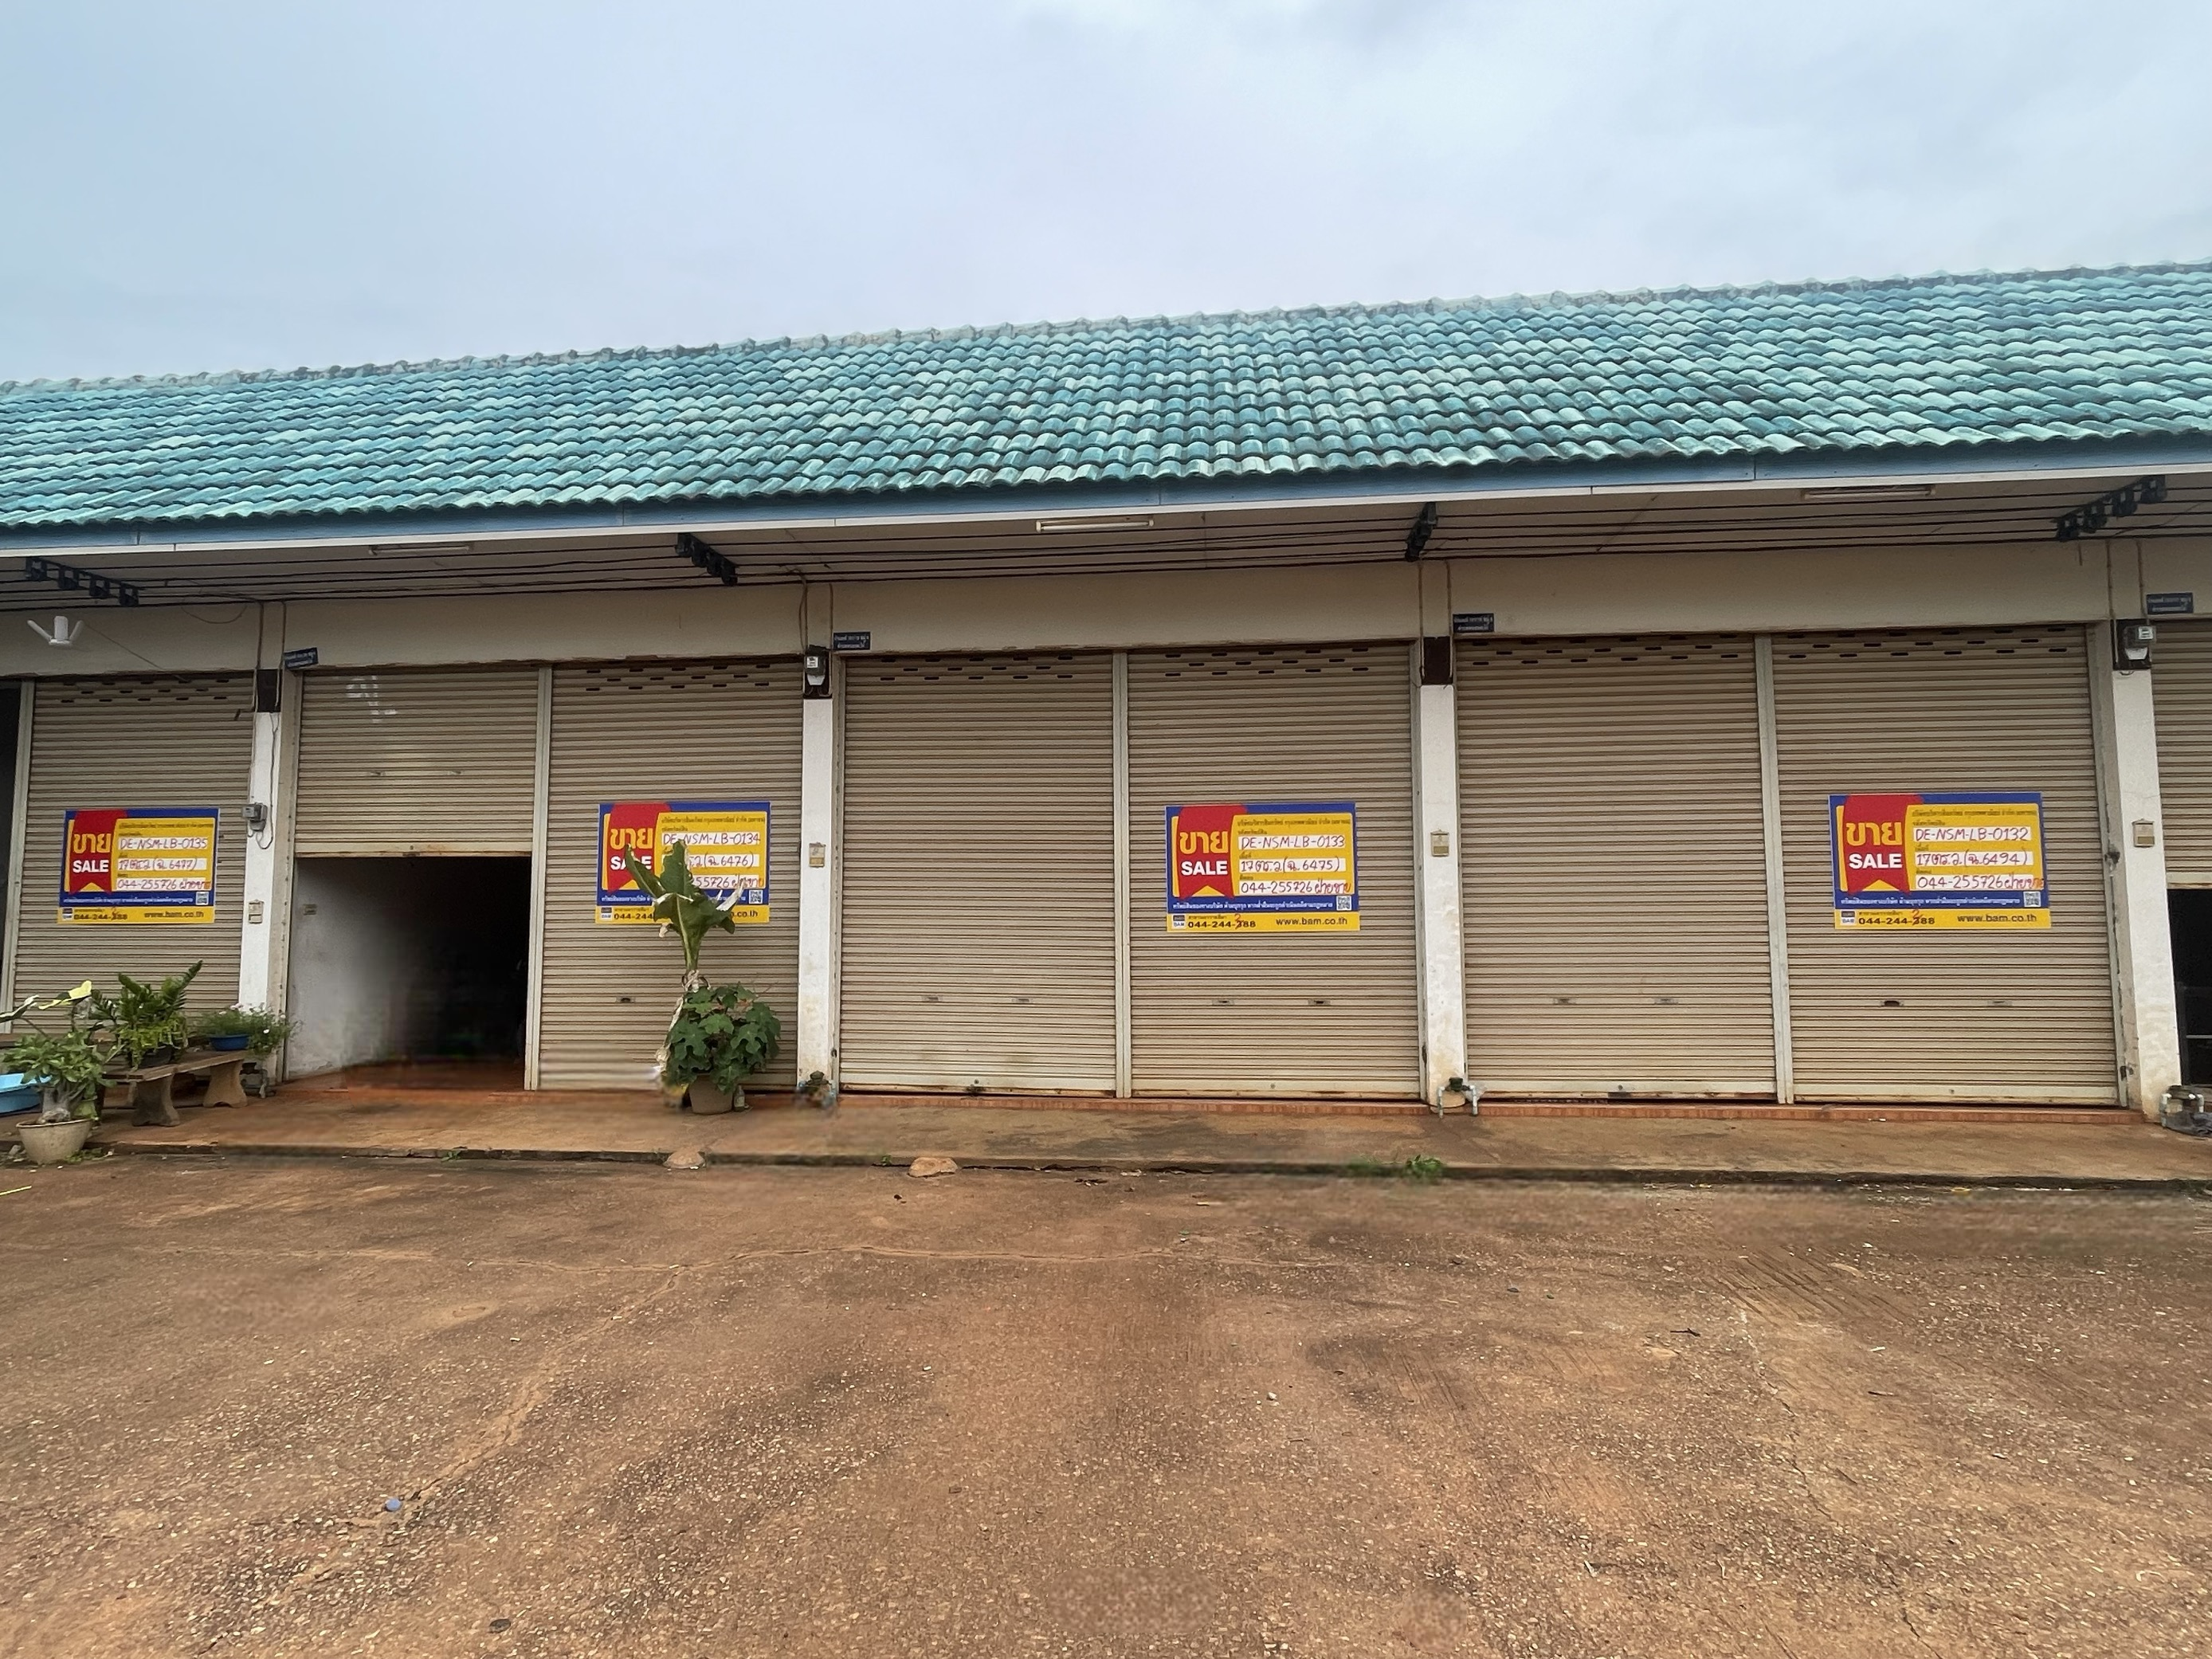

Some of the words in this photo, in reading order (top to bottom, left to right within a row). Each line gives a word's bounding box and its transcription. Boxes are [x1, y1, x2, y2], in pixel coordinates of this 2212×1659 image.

[610, 828, 653, 849] ขาย
[1845, 822, 1903, 846] ขาย
[1916, 827, 2029, 841] DE-NSM-LB-0132
[73, 833, 111, 853] ขาย
[1179, 831, 1229, 854] ขาย
[1241, 835, 1345, 850] DE-NSM-LB-0133
[73, 860, 109, 873] SALE
[1181, 861, 1228, 876] SALE
[1849, 853, 1903, 869] SALE
[1241, 880, 1312, 894] 044-255726
[1917, 876, 2003, 889] 044-255726
[1276, 916, 1347, 925] www.bam.co.th
